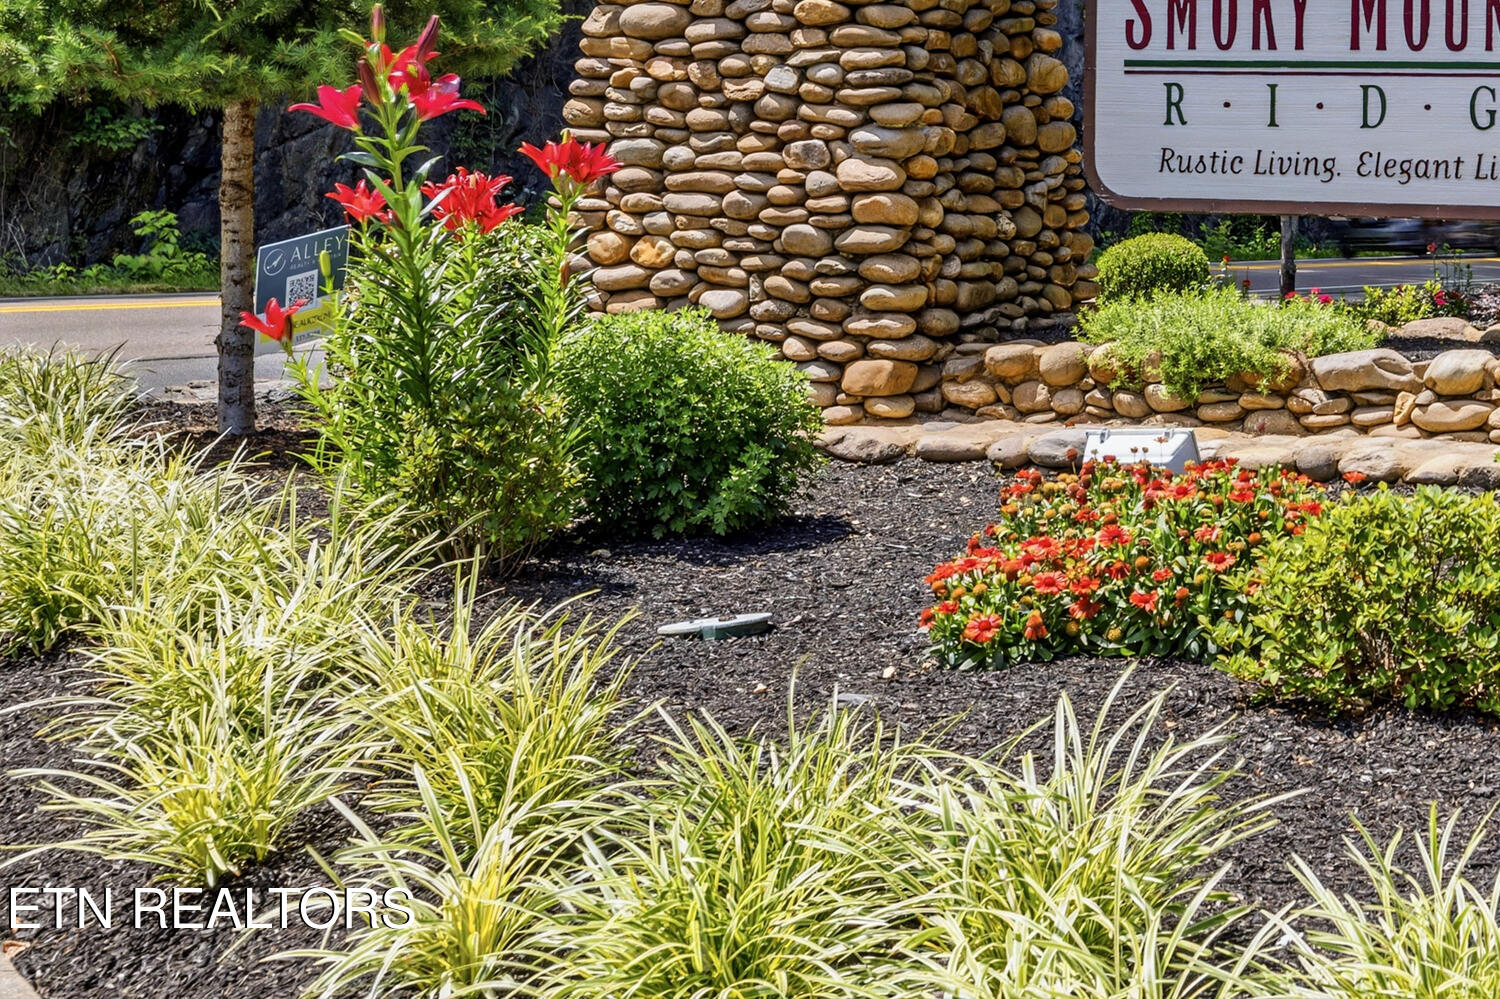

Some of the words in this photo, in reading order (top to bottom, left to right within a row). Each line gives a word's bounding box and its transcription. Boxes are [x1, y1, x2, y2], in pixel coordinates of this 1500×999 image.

[1159, 147, 1243, 175] Rustic
[1253, 149, 1342, 183] Living.
[1356, 151, 1465, 184] Elegant
[290, 234, 345, 262] ALLEY
